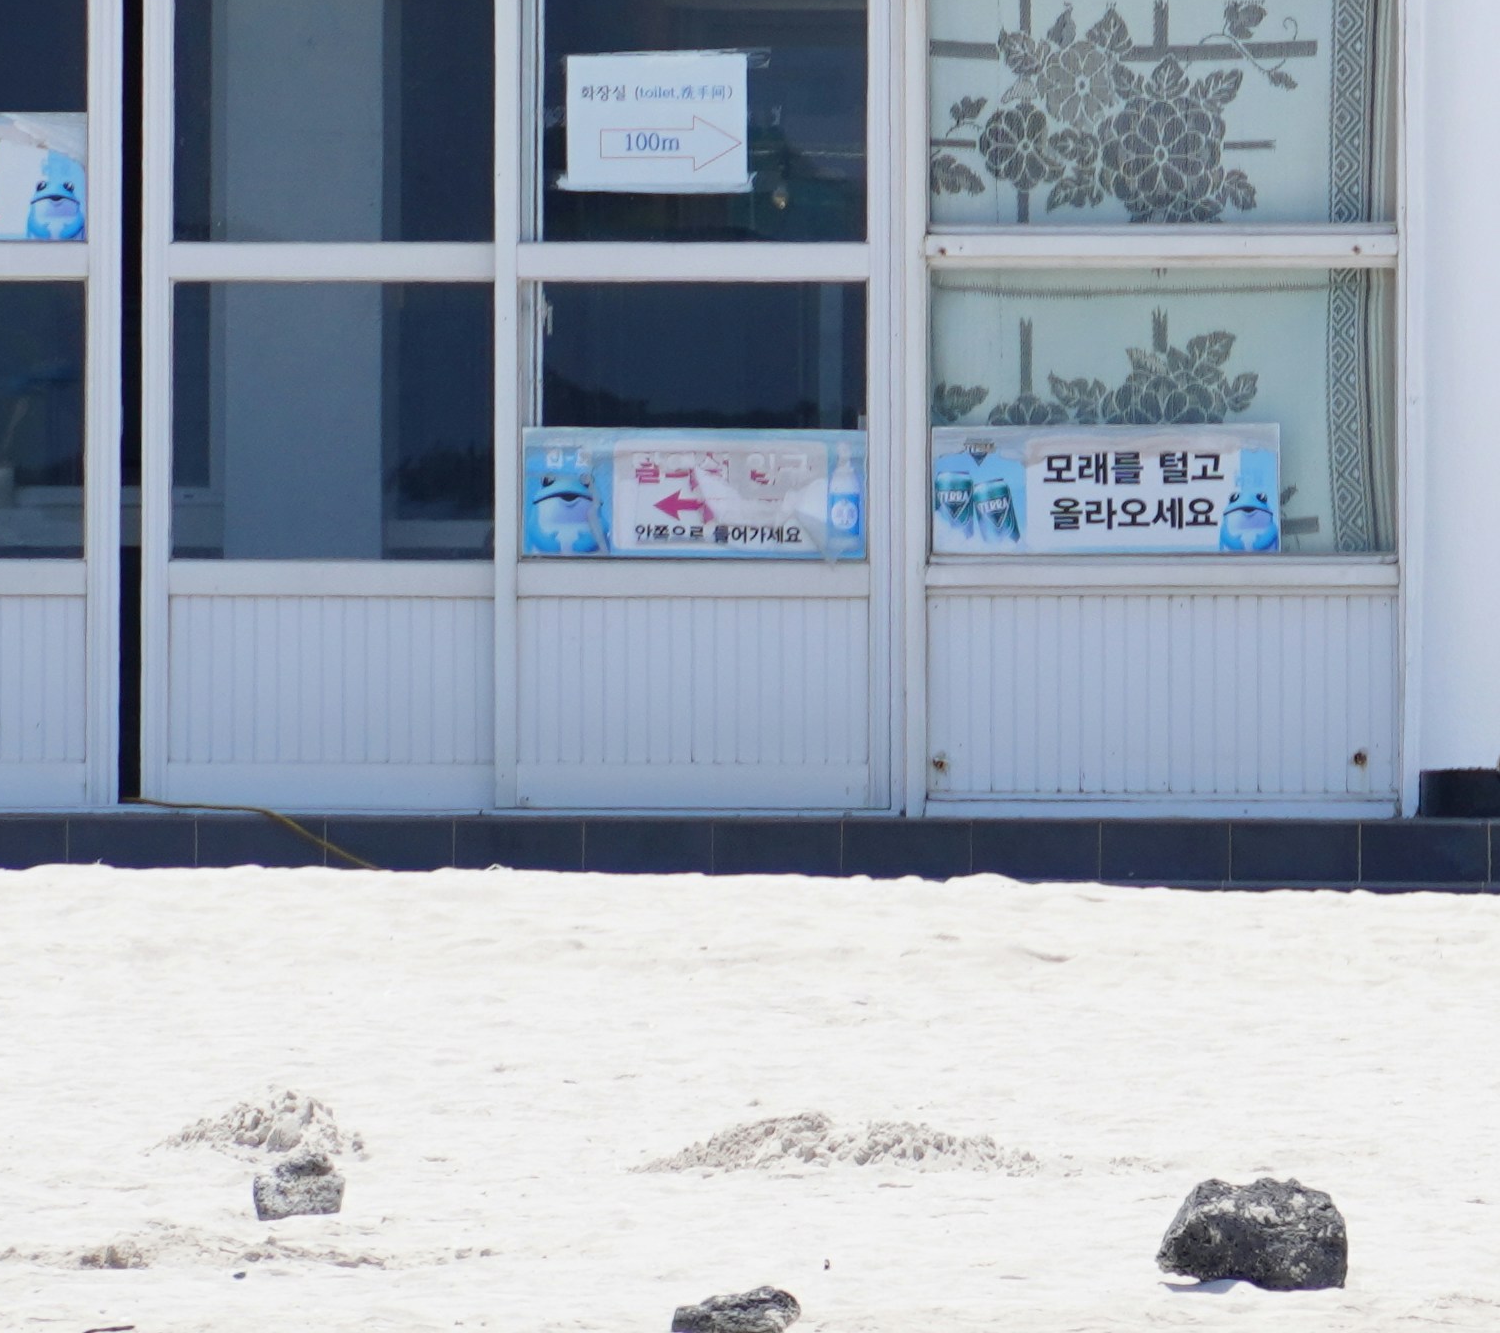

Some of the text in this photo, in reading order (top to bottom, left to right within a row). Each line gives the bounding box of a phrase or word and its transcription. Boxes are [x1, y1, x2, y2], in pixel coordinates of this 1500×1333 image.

[581, 85, 626, 102] 화장실
[625, 132, 680, 152] 100m
[1043, 451, 1225, 485] 모래를 털고
[1049, 497, 1219, 530] 올라오세요
[713, 524, 803, 544] 들어가세요
